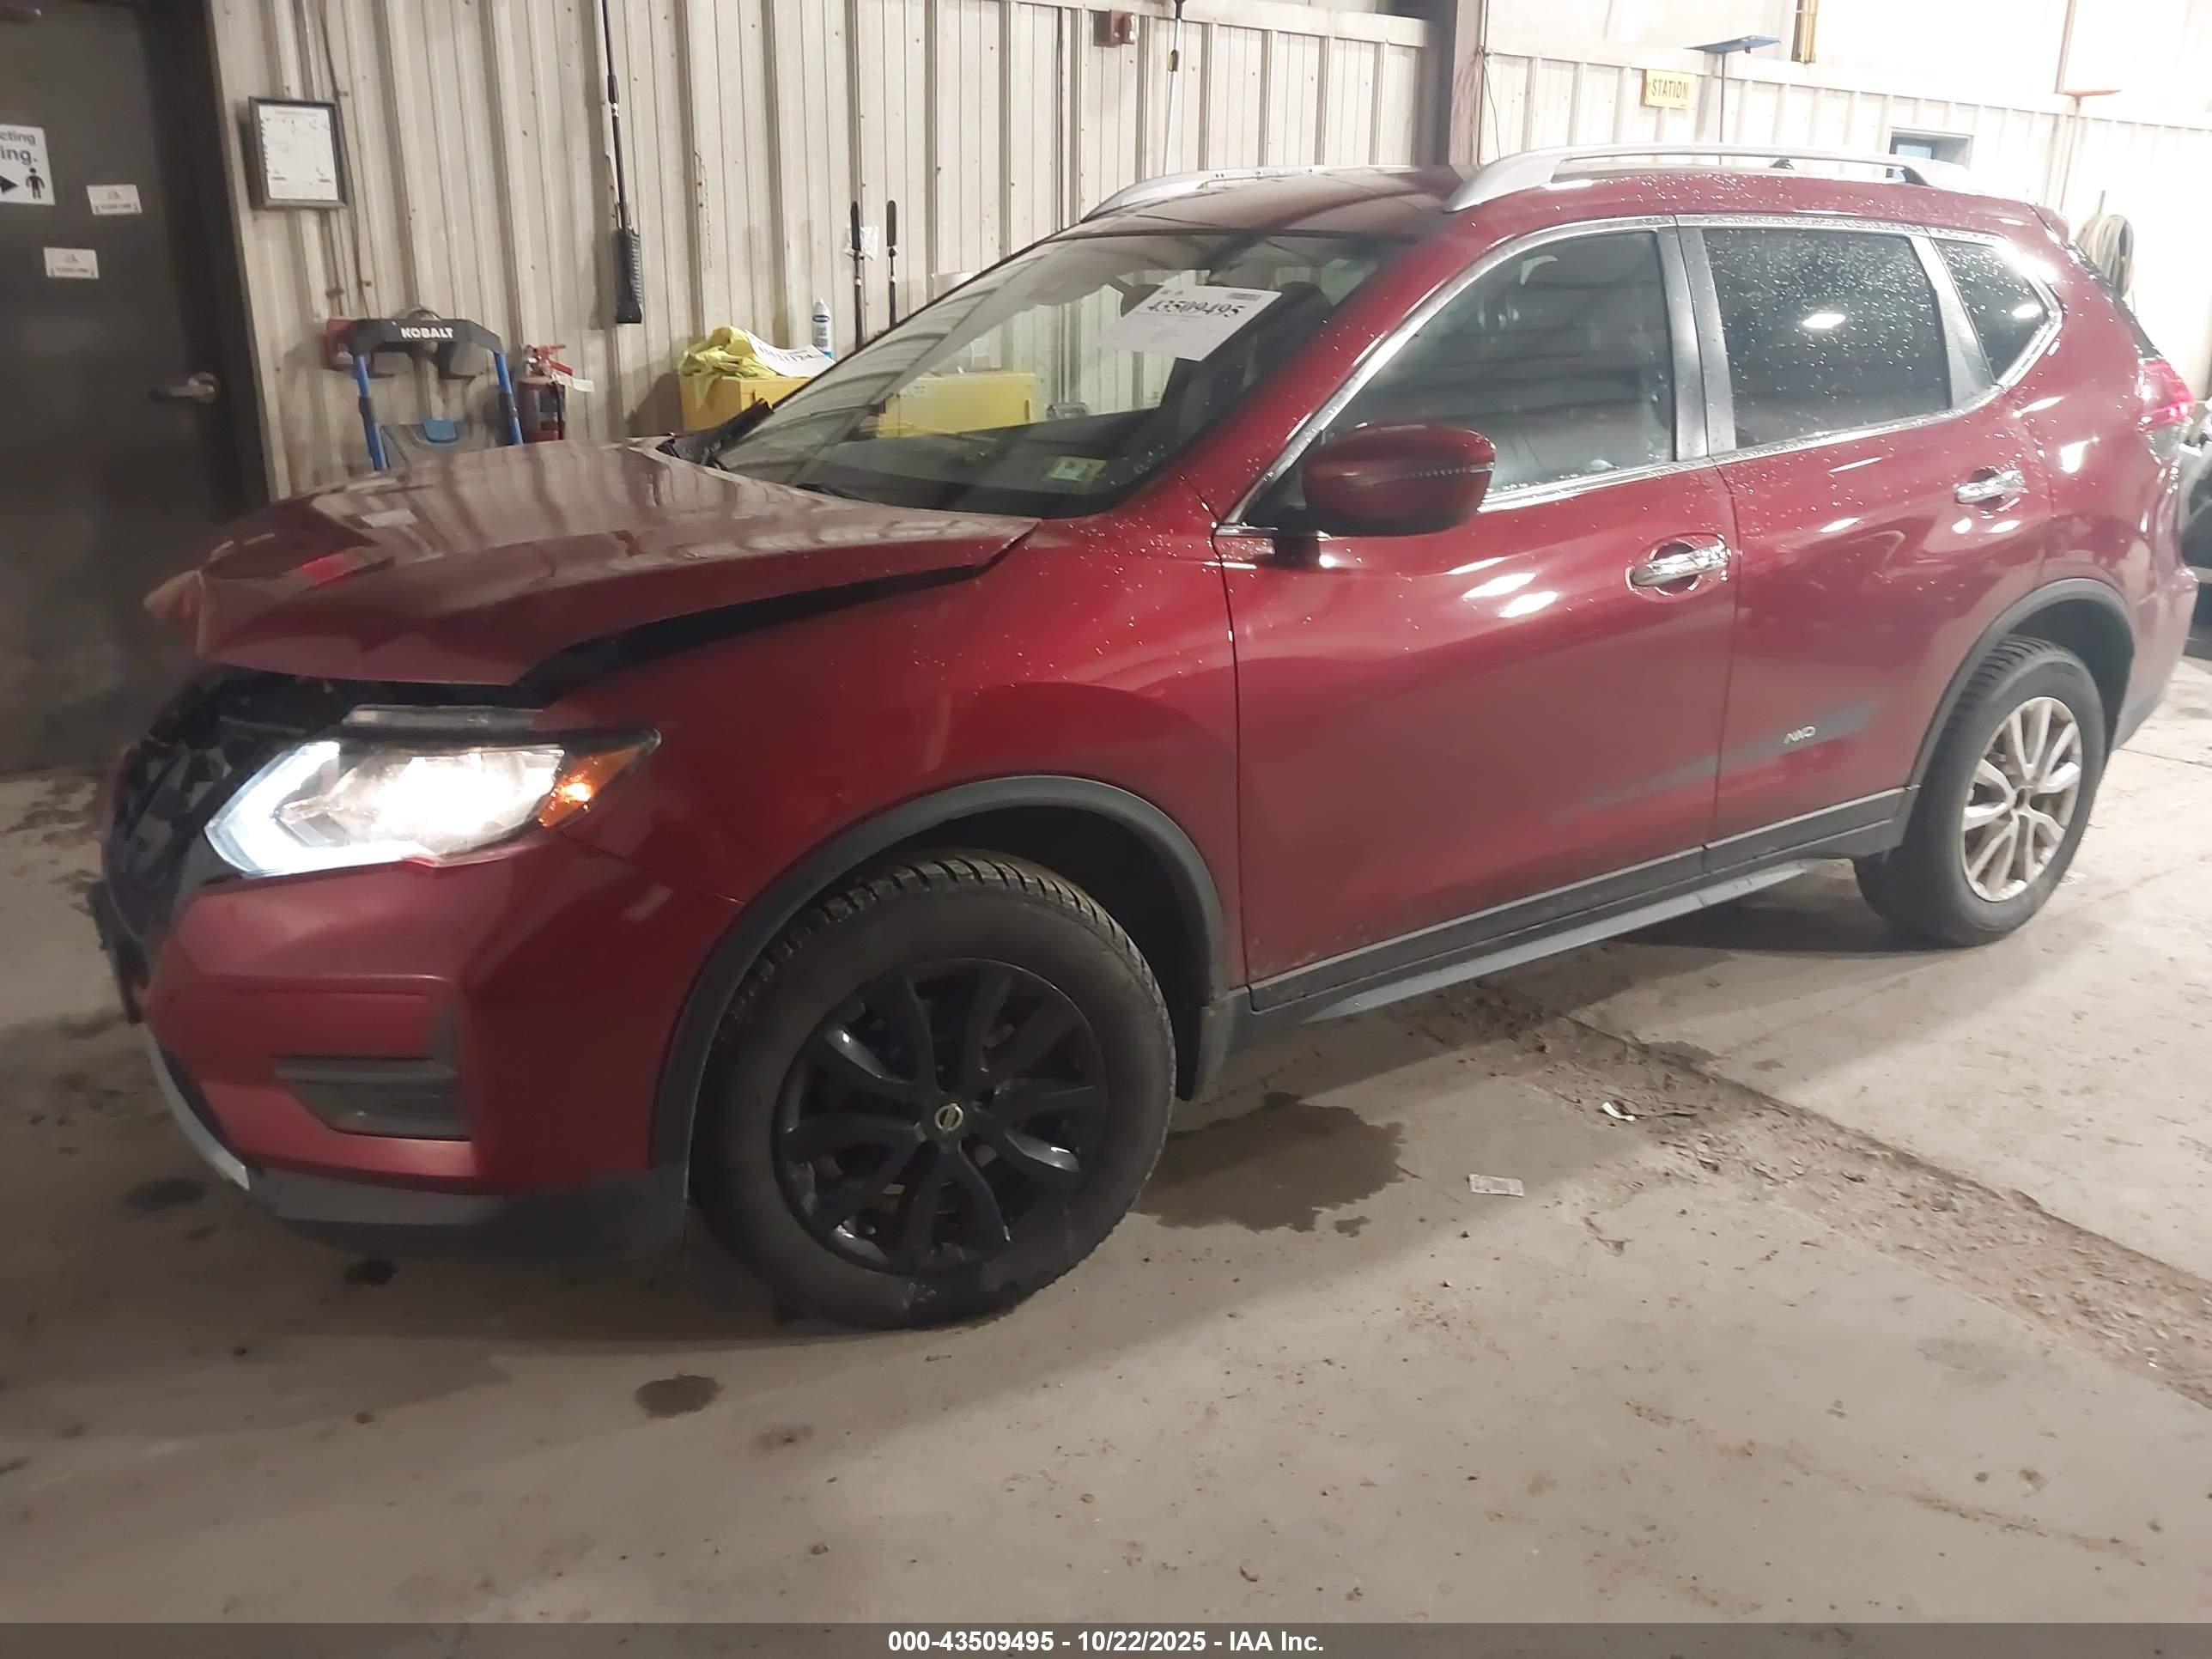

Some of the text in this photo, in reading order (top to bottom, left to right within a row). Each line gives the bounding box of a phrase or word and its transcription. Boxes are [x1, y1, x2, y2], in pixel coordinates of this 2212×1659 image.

[1651, 78, 1689, 100] STATION
[1147, 299, 1246, 318] 43509495
[400, 326, 454, 339] KOBALT
